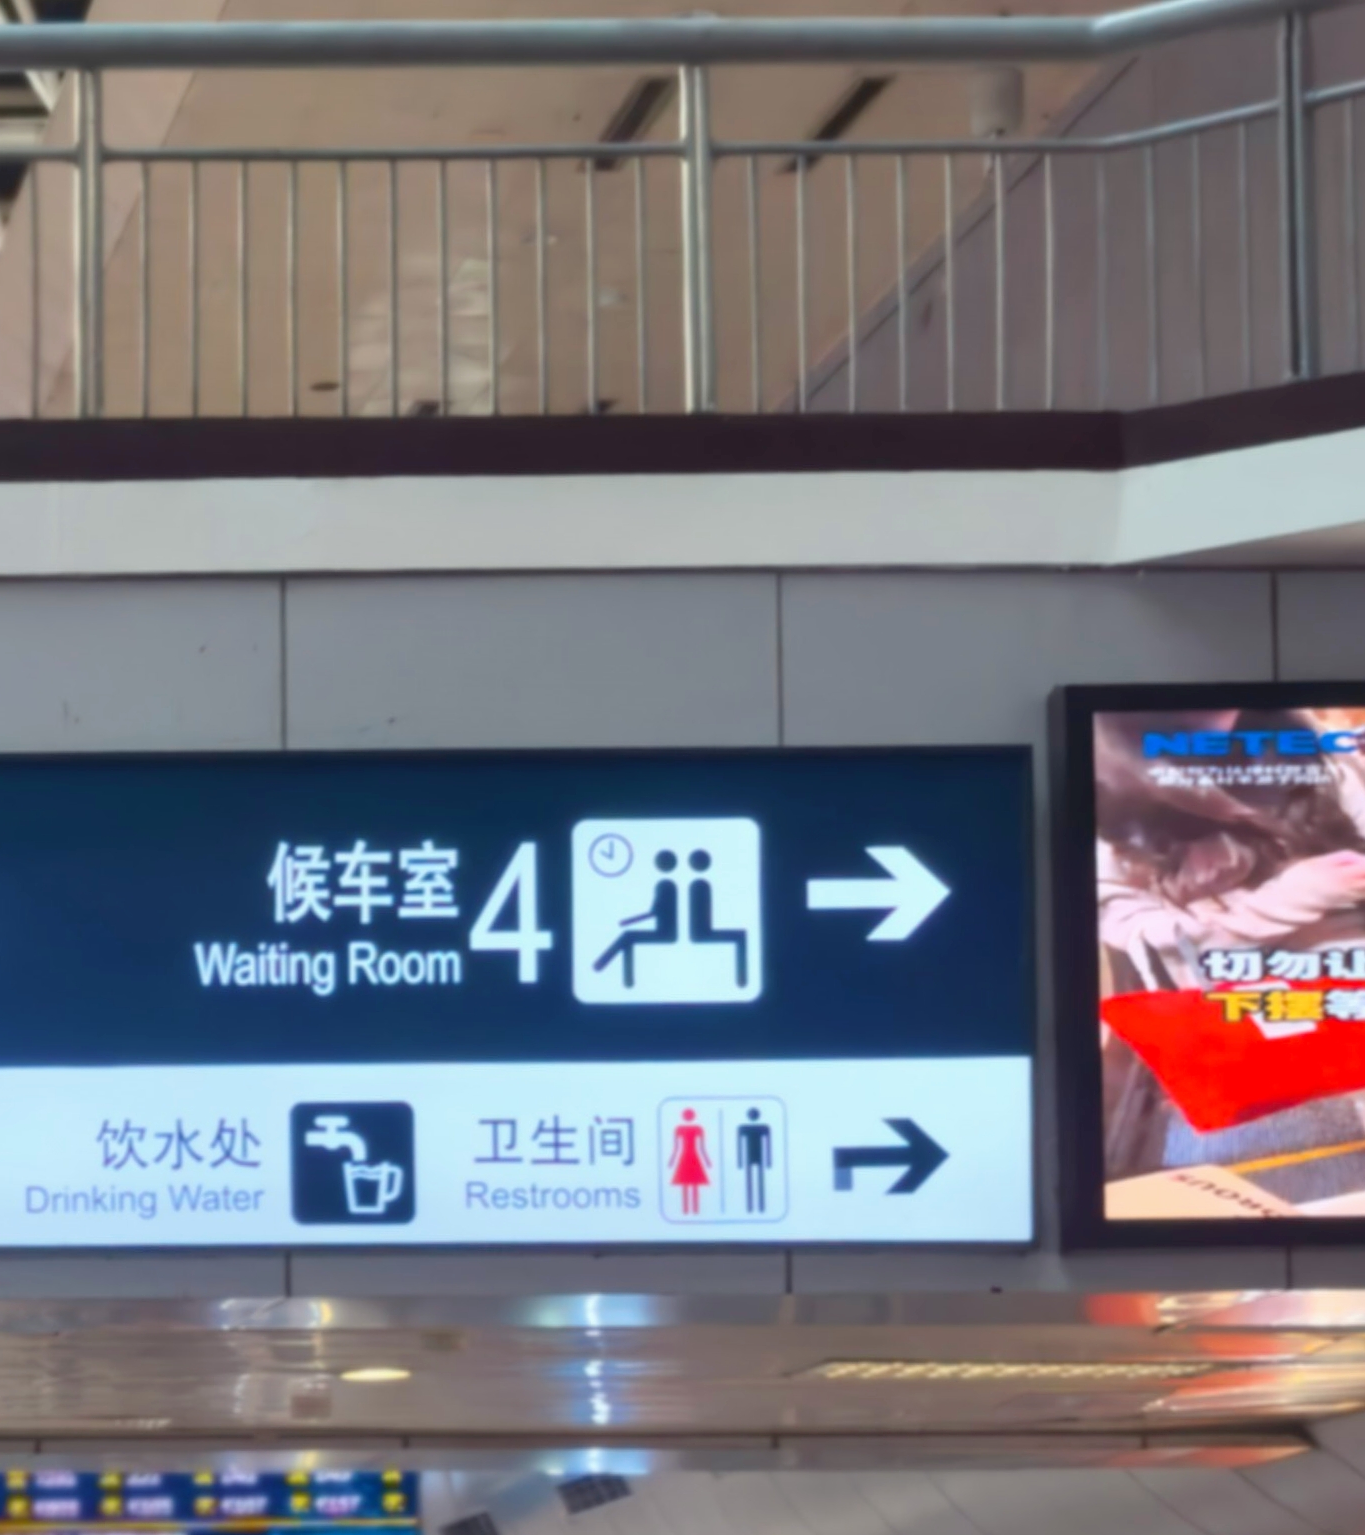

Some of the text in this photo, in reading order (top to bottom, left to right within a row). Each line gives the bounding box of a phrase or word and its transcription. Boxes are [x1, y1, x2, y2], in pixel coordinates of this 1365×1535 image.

[266, 839, 460, 925] 候车室
[468, 841, 554, 984] 4
[193, 940, 462, 997] Waiting Room
[96, 1117, 261, 1171] 饮水处
[473, 1114, 635, 1167] 卫生间
[24, 1183, 266, 1221] Drinking Water
[464, 1180, 642, 1211] Restrooms
